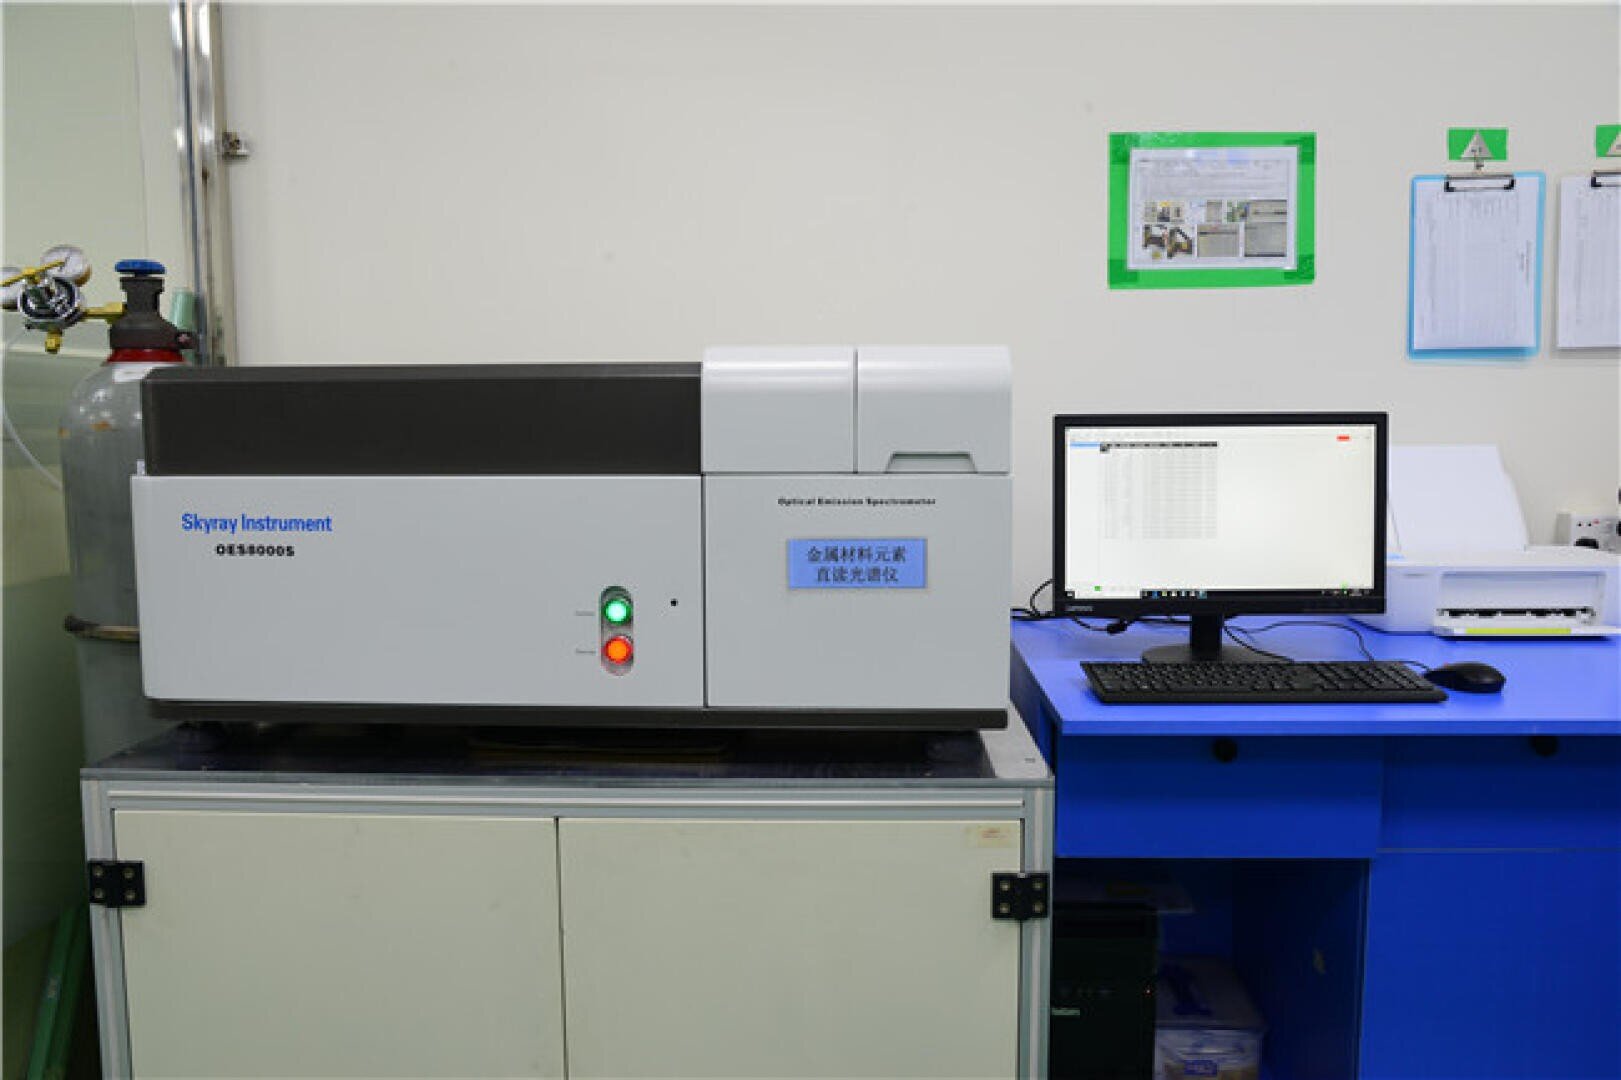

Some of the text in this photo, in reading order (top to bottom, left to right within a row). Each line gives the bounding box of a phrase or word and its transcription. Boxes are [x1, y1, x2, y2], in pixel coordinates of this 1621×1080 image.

[181, 512, 333, 535] Skyray Instrument
[807, 545, 907, 563] 金属材料元素
[816, 565, 899, 583] 直读光谱仪
